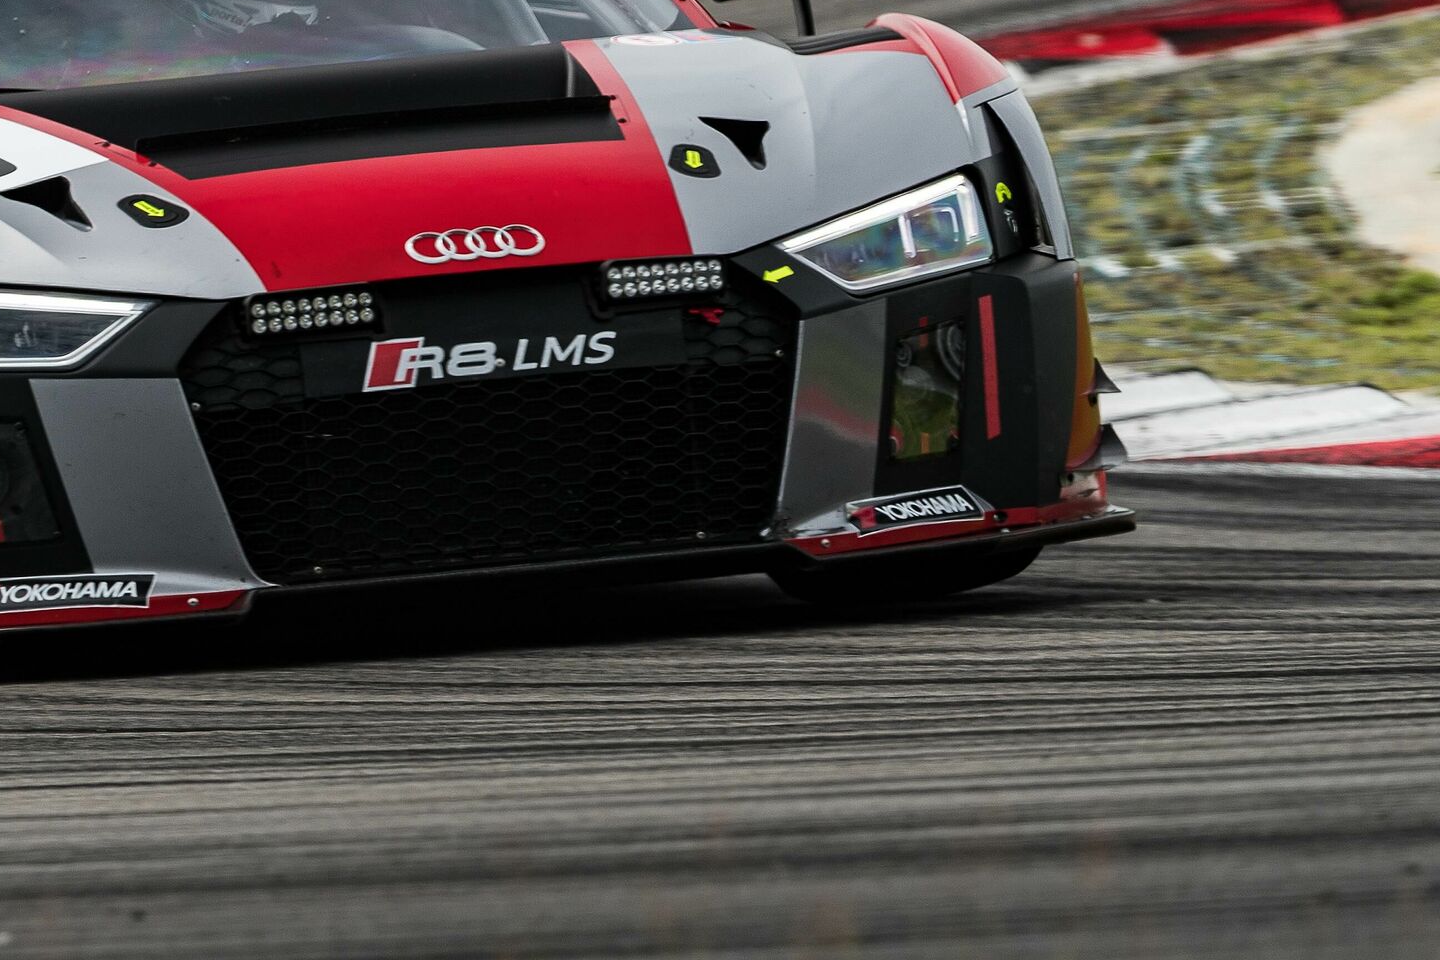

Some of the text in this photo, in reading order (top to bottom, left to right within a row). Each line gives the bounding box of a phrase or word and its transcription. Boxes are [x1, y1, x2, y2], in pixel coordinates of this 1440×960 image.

[393, 331, 617, 382] R8 LMS
[875, 493, 974, 521] YOKOHAMA
[0, 581, 138, 604] YOKOHAMA
